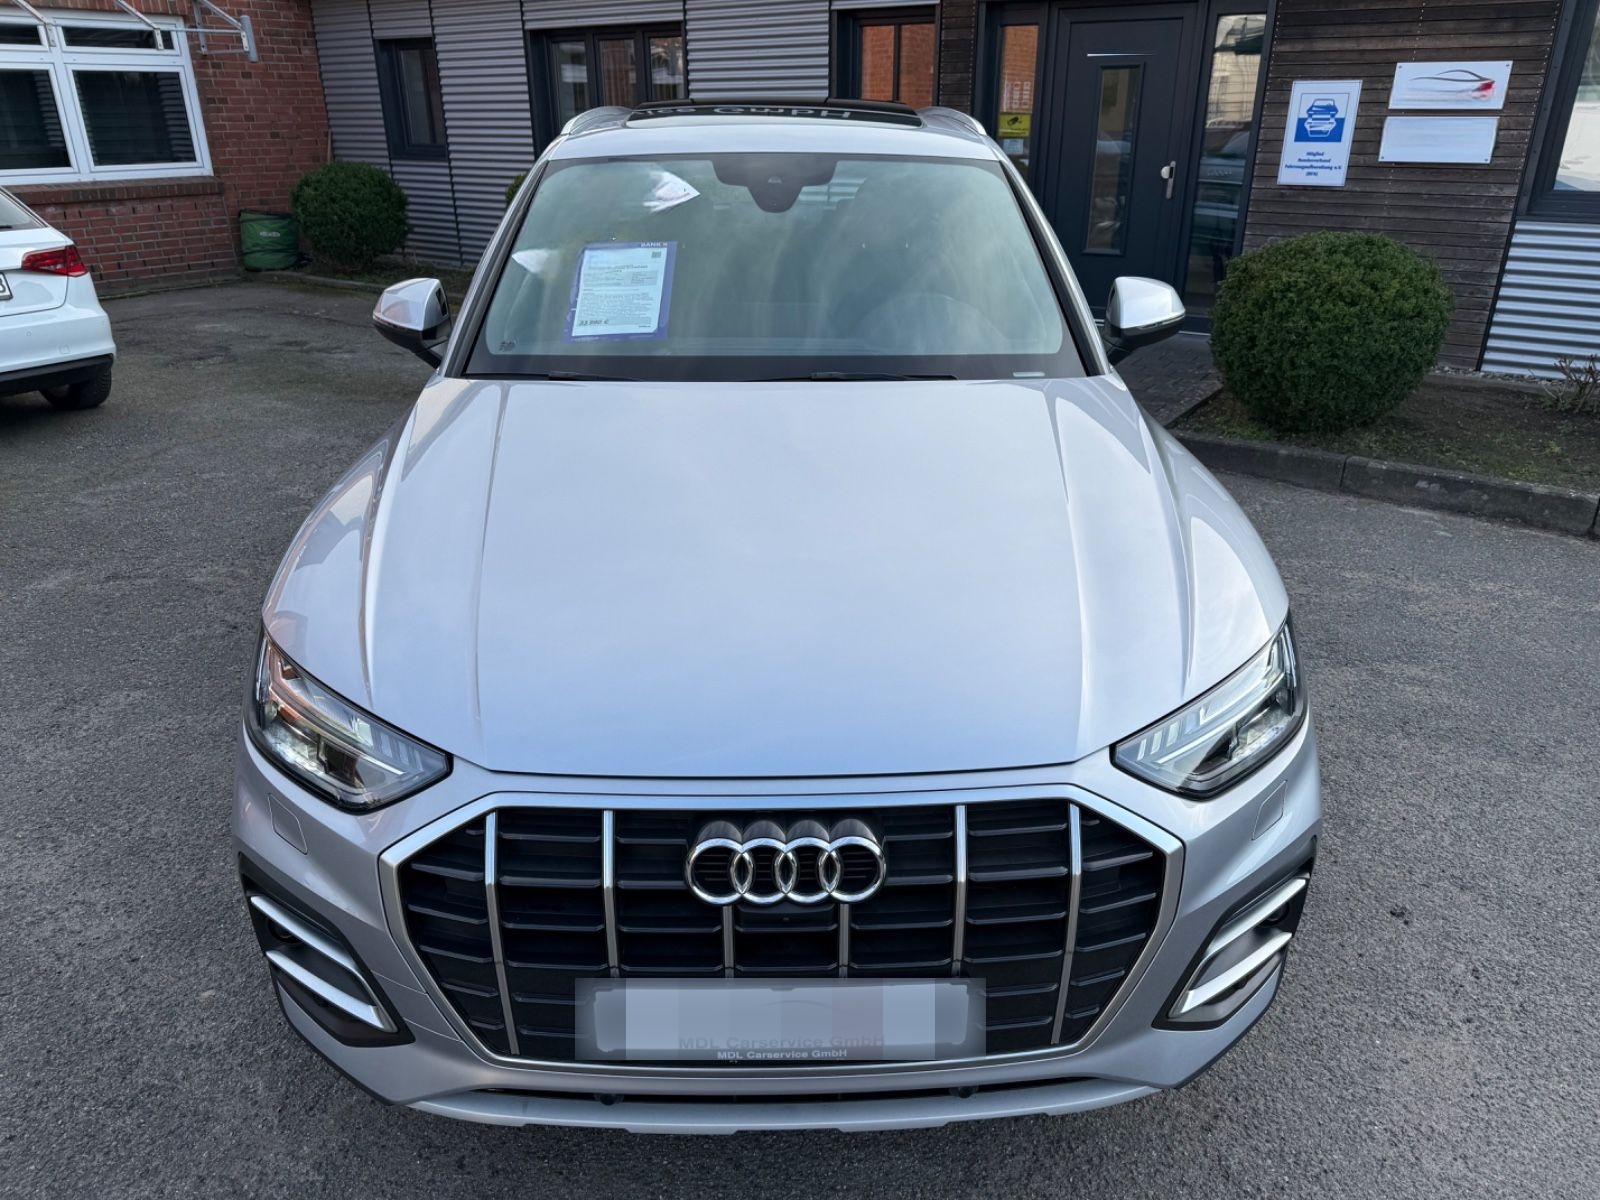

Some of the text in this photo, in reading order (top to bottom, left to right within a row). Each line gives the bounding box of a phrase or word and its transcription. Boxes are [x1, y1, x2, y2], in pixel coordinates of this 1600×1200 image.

[679, 1034, 884, 1049] MDL Carservice GmbH
[717, 1049, 847, 1059] MDL Carservice GmbH
